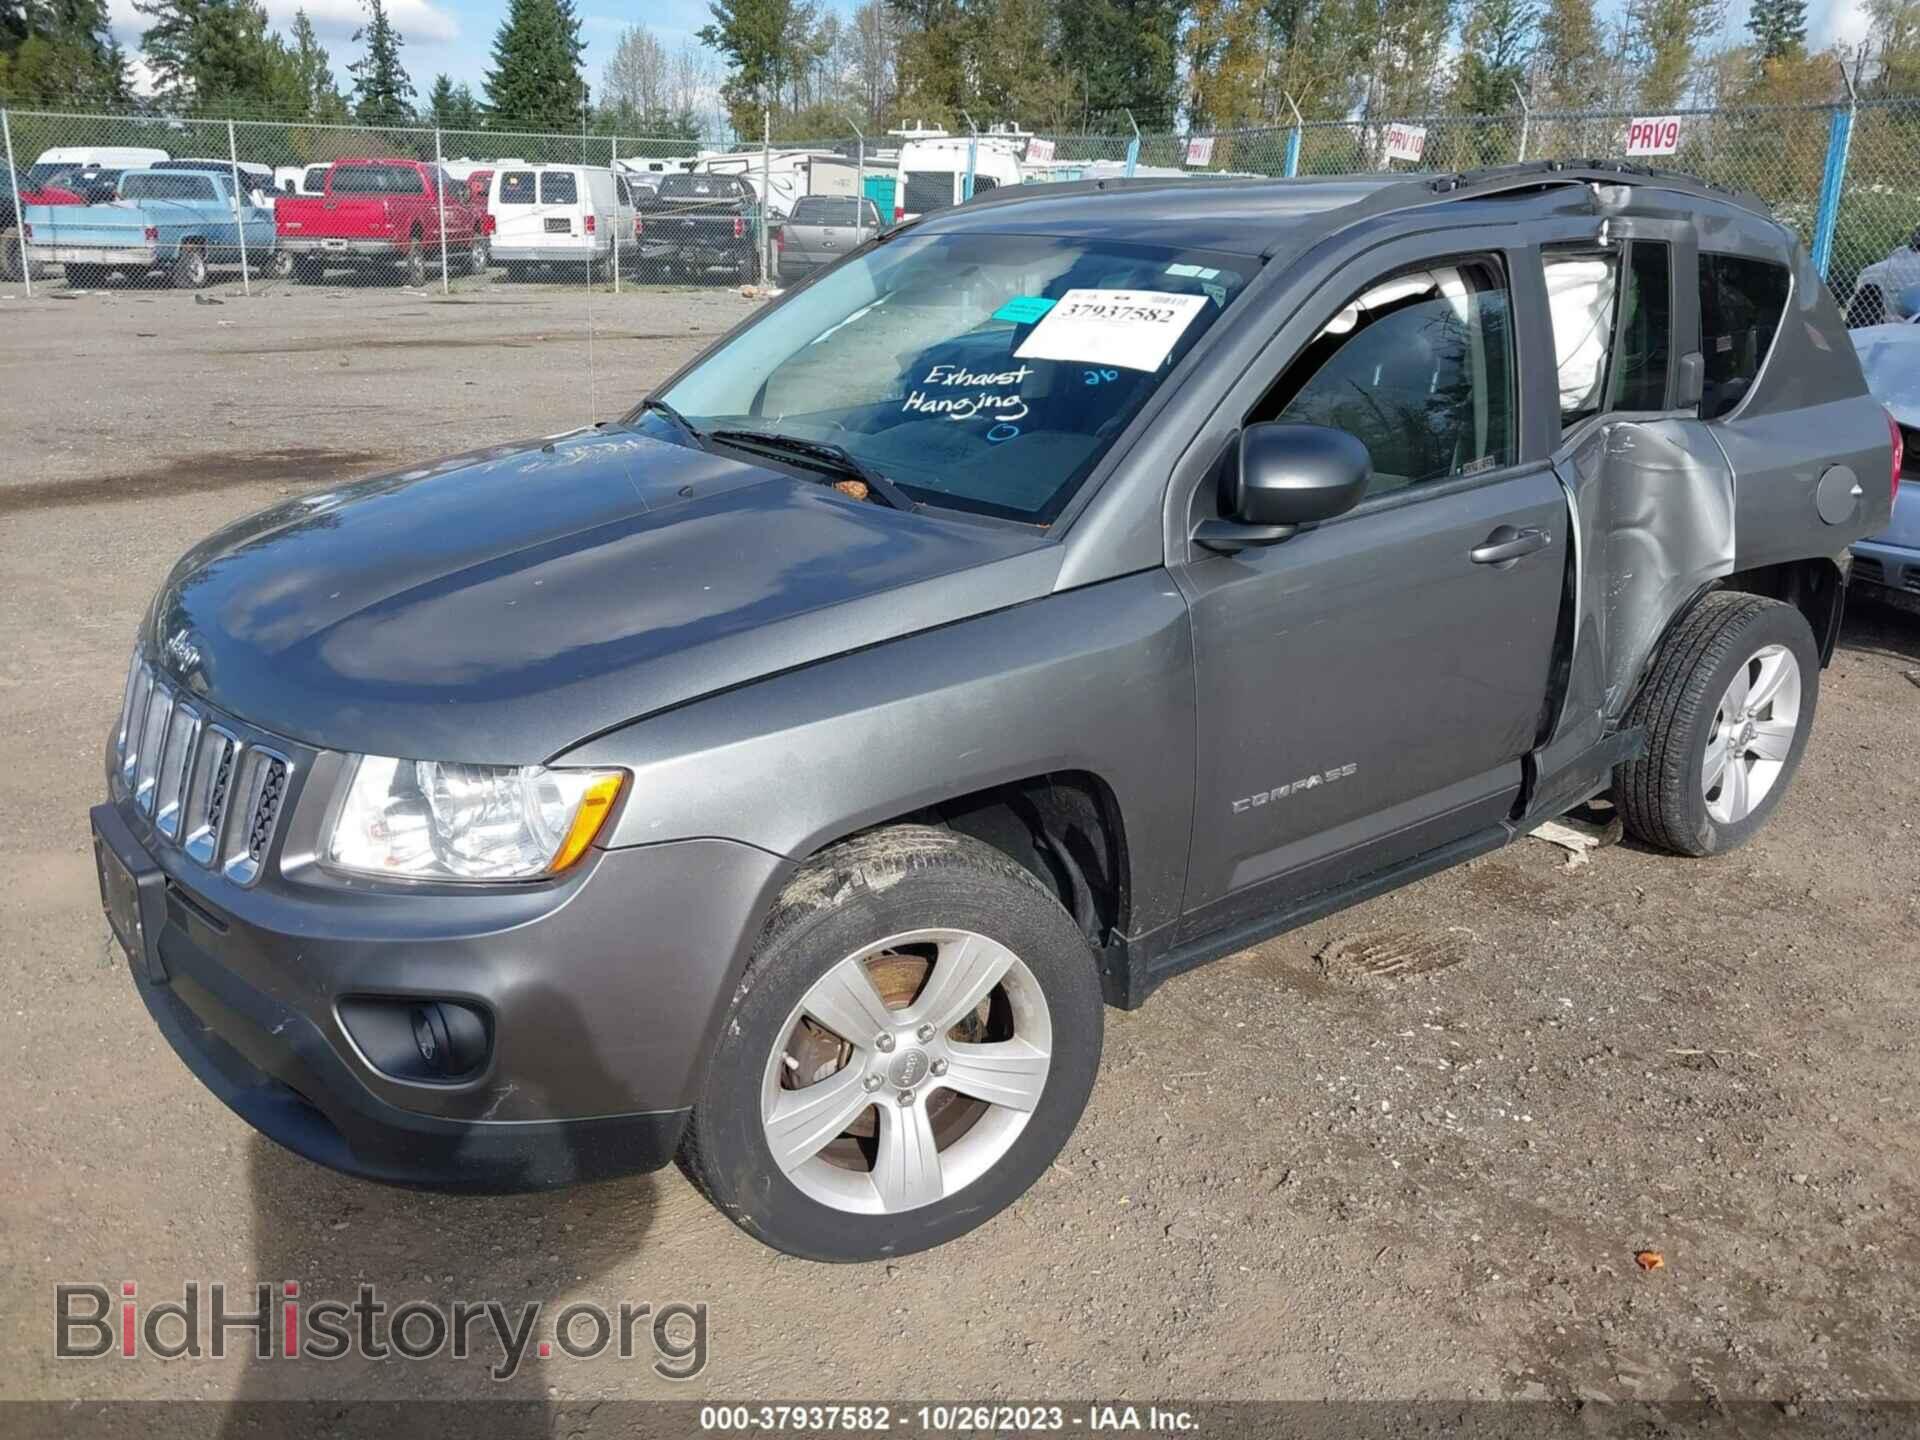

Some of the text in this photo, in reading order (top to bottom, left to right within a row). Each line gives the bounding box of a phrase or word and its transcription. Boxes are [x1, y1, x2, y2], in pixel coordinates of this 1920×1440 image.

[1629, 122, 1678, 149] PRV9
[1061, 303, 1175, 324] 37937582
[923, 364, 1035, 386] Exhaust
[901, 390, 1029, 421] Hanging
[1231, 762, 1358, 815] COMPASS
